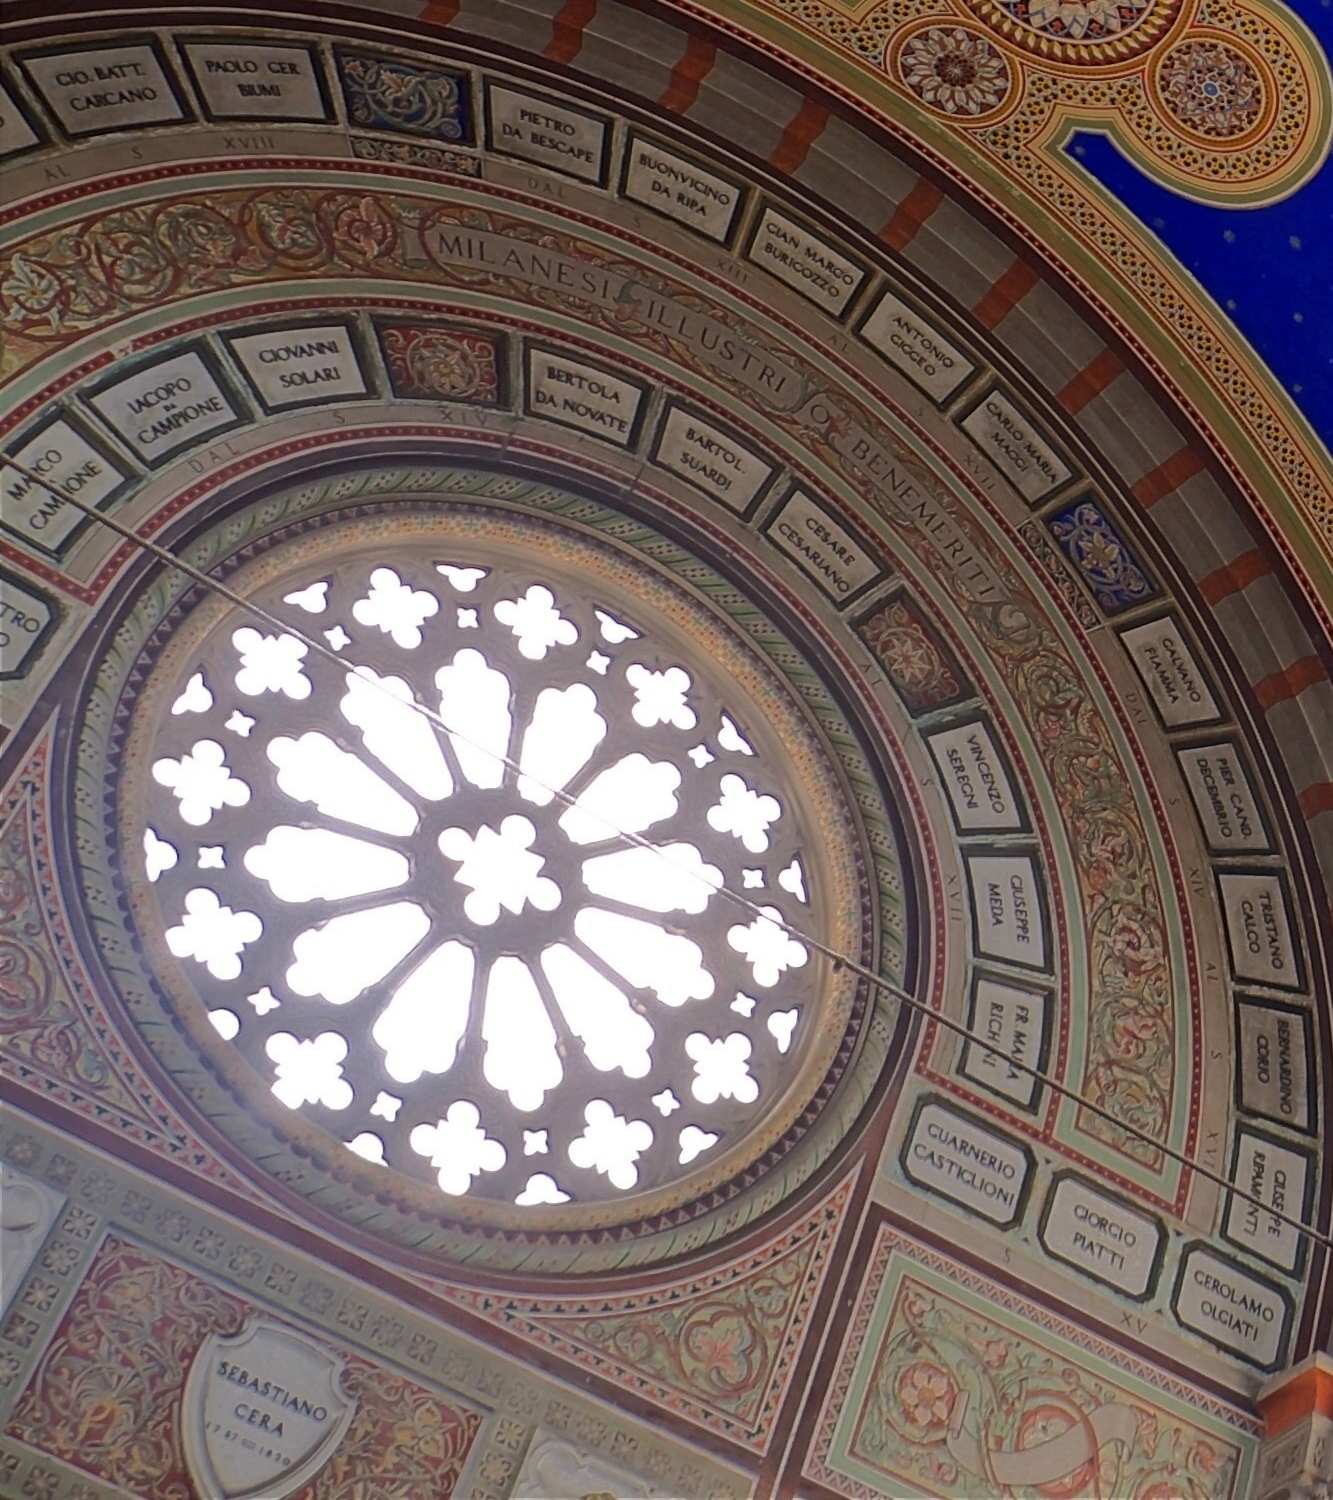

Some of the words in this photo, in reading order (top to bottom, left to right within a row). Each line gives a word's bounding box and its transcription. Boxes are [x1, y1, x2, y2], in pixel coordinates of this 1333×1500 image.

[205, 59, 257, 74] PAOLO
[70, 87, 157, 112] CARCANO
[520, 110, 576, 137] PIETRO
[502, 123, 522, 140] DA
[639, 153, 731, 206] BUONVICINO
[651, 181, 671, 198] DA
[676, 194, 707, 217] RIPA
[804, 244, 854, 286] MARCO
[892, 316, 954, 368] ANTONIO
[127, 377, 192, 415] IACOPO
[279, 368, 341, 389] SOLARI
[548, 366, 621, 404] BERTOLA
[136, 396, 225, 445] CAMPIONE
[437, 232, 609, 299] MILANESI
[647, 301, 786, 393] ILLUSTRI
[851, 437, 996, 597] BENEMERITI
[536, 389, 556, 408] DA
[563, 397, 629, 434] NOVATE
[685, 427, 748, 475] BARTOL.
[986, 401, 1024, 443] CARLO
[1023, 442, 1058, 485] MARIA
[29, 460, 103, 530] CAMIONE
[680, 452, 733, 491] SUARDI
[777, 521, 850, 594] CESARIANO
[805, 516, 857, 567] CESARE
[1144, 646, 1180, 706] FIAMMA
[1163, 638, 1201, 704] GALVANO
[966, 734, 1006, 814] VINCENZO
[1197, 757, 1233, 839] DECEMBRIO
[1216, 757, 1236, 787] PIER
[988, 882, 1005, 928] MEDA
[1010, 874, 1030, 945] GIUSEPPE
[1240, 900, 1261, 956] CALCO
[1259, 890, 1285, 971] TRISTANO
[982, 1002, 1004, 1068] RICHNI
[1256, 1034, 1270, 1085] CORIO
[1275, 1020, 1294, 1116] BERNARDINO
[913, 1143, 1015, 1210] CASTIGLIONI
[926, 1121, 1017, 1182] GUARNERIO
[1243, 1150, 1266, 1236] RIPAMNTI
[1267, 1168, 1287, 1238] GIUSEPE
[1072, 1231, 1125, 1272] PIATTI
[1193, 1269, 1275, 1324] GEROLAMO
[1119, 1311, 1150, 1337] XV
[217, 1360, 328, 1422] SEBASTIANO
[234, 1403, 284, 1438] CERA
